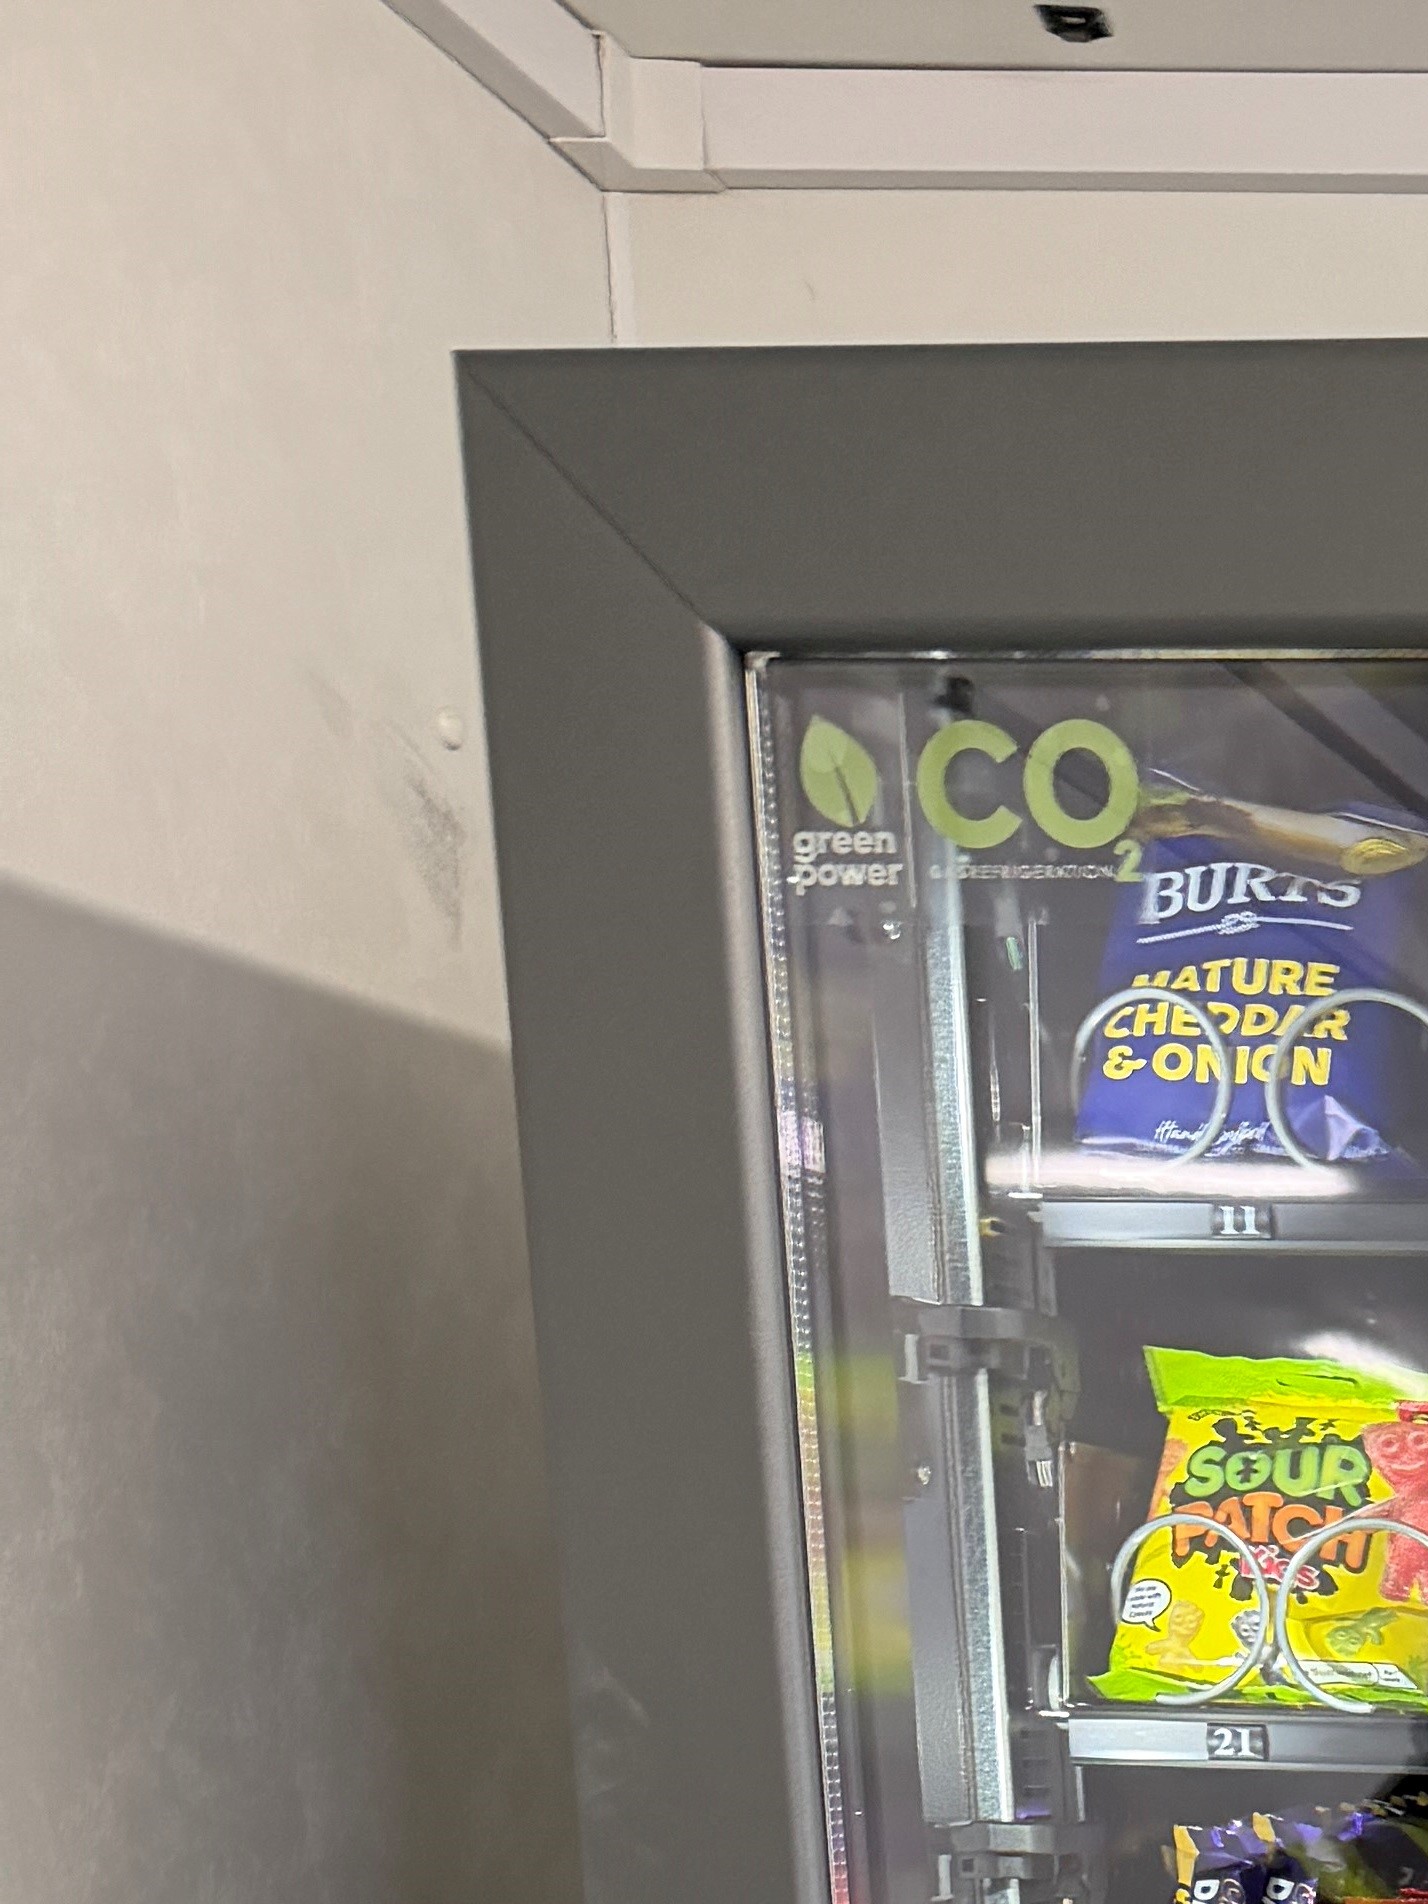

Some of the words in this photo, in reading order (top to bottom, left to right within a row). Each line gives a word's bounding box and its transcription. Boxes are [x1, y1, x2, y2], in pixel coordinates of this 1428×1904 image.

[793, 831, 898, 863] green
[793, 864, 904, 896] power
[1138, 861, 1362, 925] BURTS
[1103, 1045, 1147, 1080] &
[1220, 1205, 1260, 1236] 11
[1184, 1443, 1371, 1508] SOUR
[1212, 1726, 1253, 1758] 21
